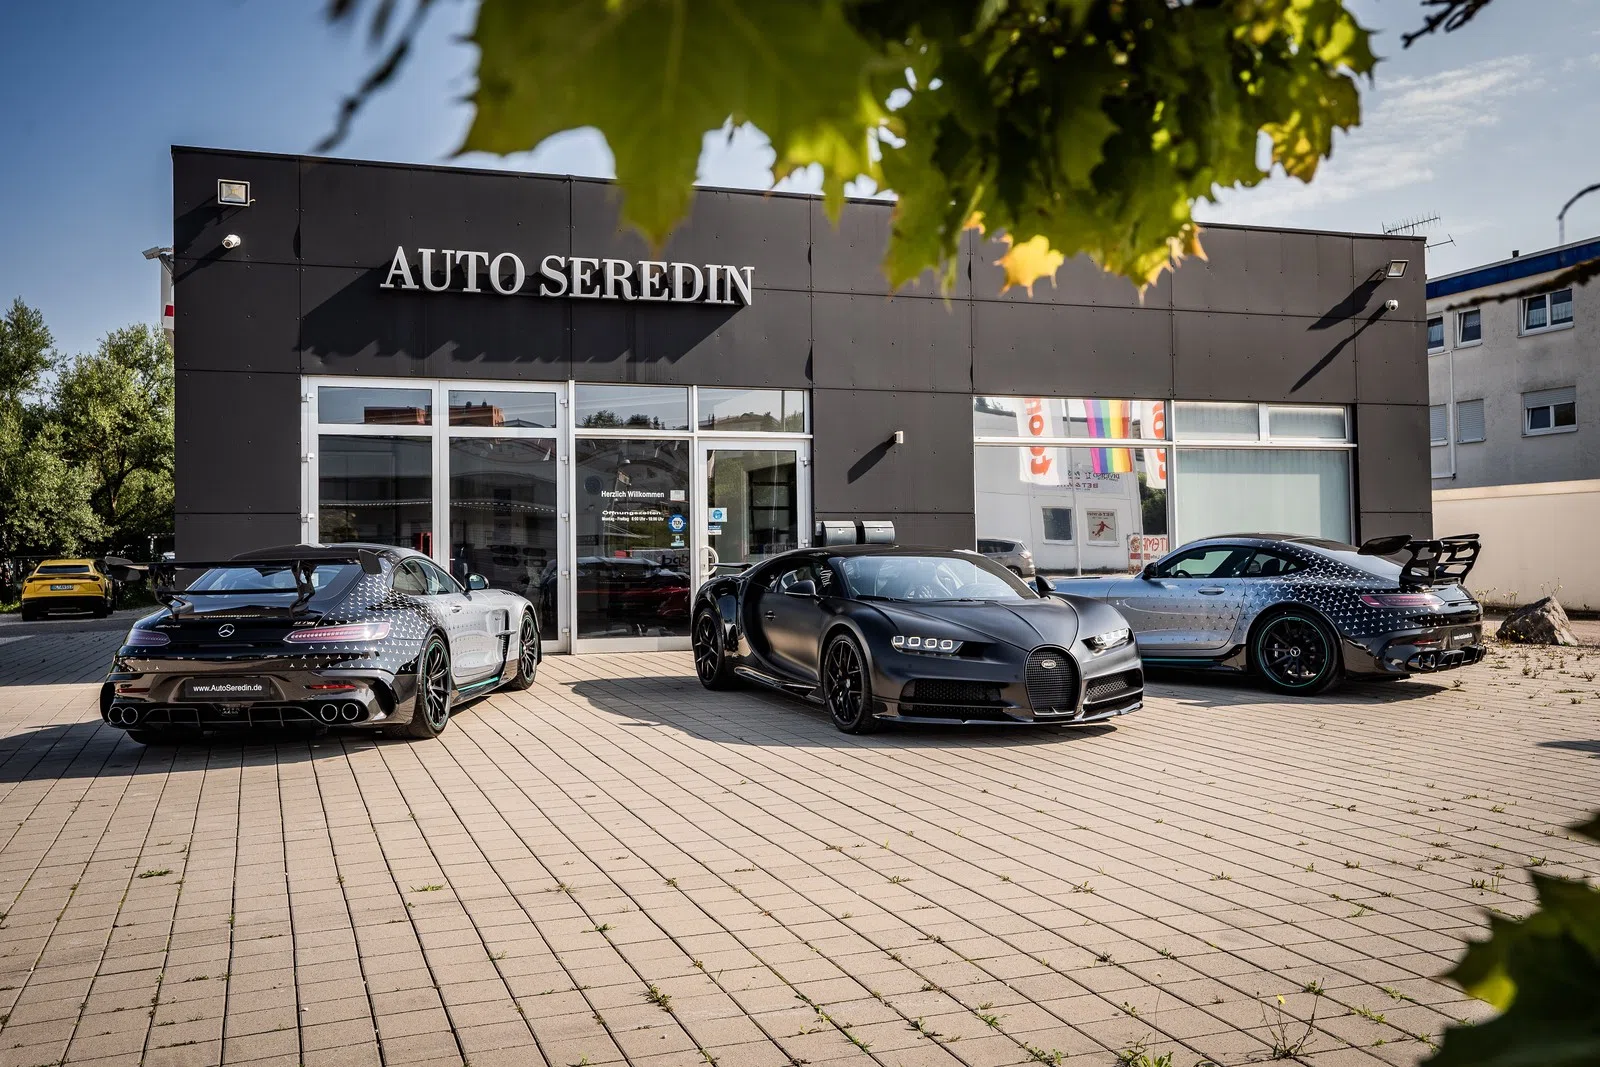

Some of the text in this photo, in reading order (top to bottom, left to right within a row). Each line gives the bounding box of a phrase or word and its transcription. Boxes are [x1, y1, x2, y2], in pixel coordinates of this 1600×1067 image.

[380, 246, 755, 306] AUTO SEREDIN
[601, 490, 626, 498] Herzlich
[628, 490, 665, 498] Willkommen
[193, 684, 263, 692] www.AutoSeredin.de
